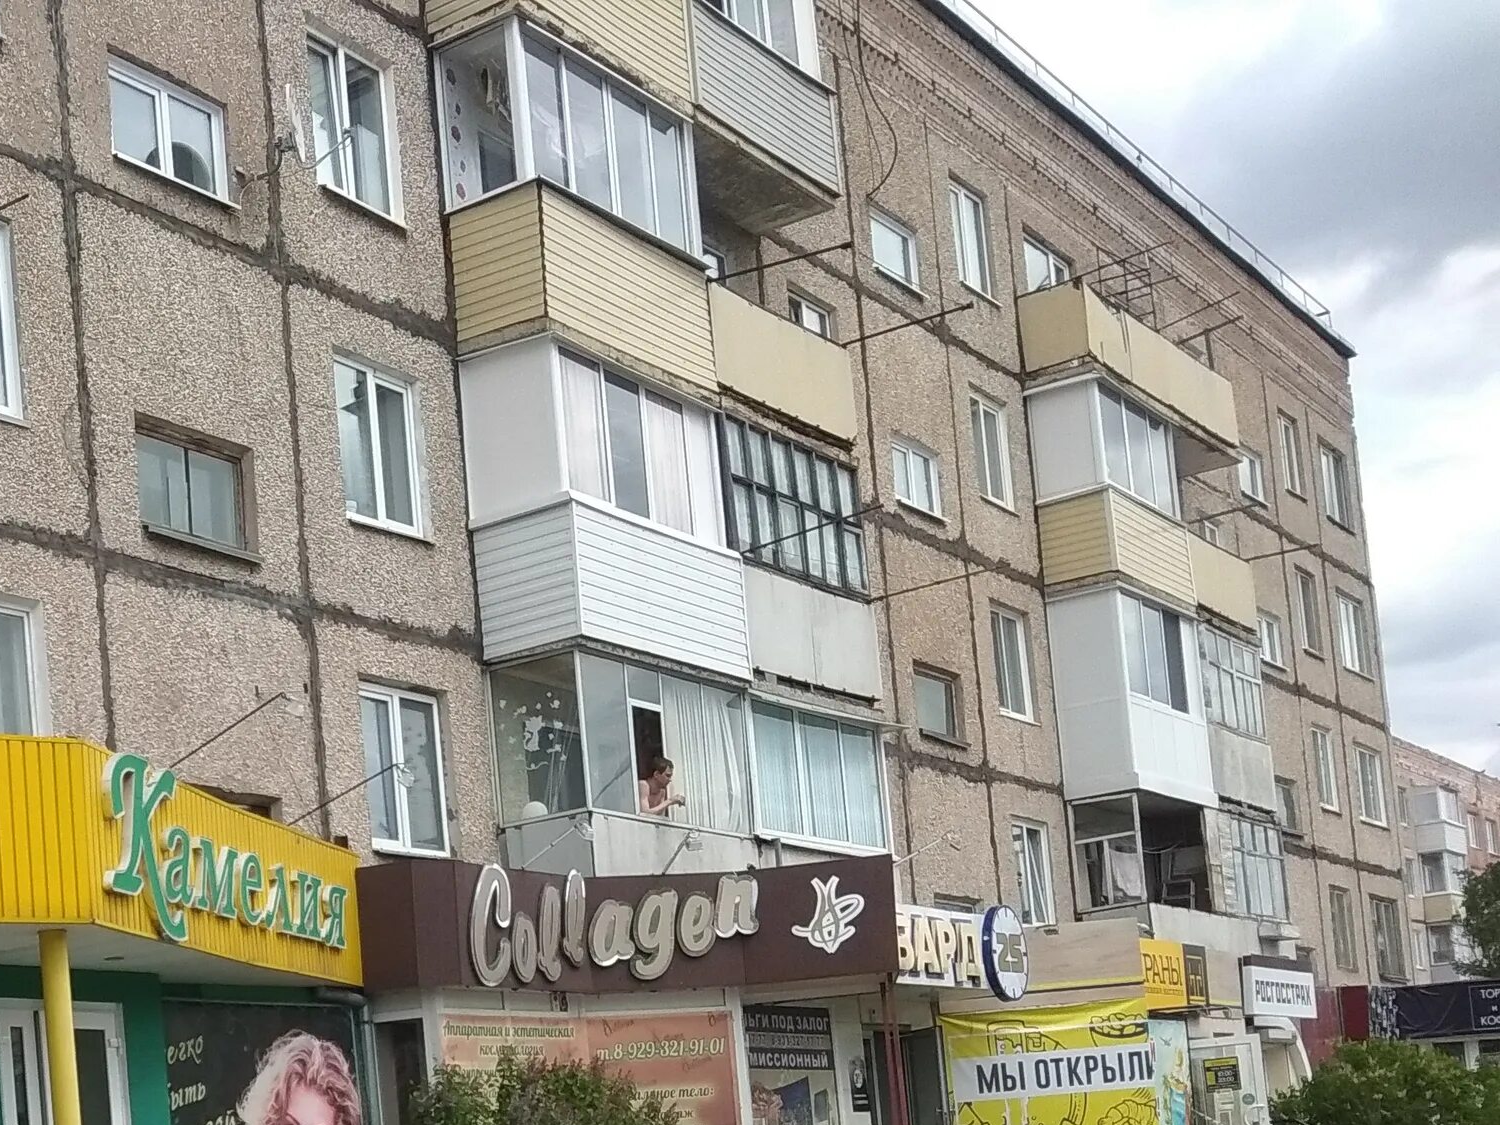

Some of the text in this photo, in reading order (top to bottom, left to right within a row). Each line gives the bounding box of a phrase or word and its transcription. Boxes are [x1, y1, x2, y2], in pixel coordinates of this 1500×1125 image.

[101, 752, 348, 949] Камелия
[468, 862, 760, 987] Collagen
[996, 932, 1024, 973] 25
[1255, 979, 1312, 1006] РОСГОССТРАХ
[442, 1020, 503, 1040] Аппаратная
[512, 1026, 575, 1038] эстетическая
[771, 1014, 794, 1032] ПОД
[795, 1016, 829, 1031] ЗАЛОГ
[976, 1059, 1026, 1094] МЫ
[167, 1082, 207, 1112] ыть
